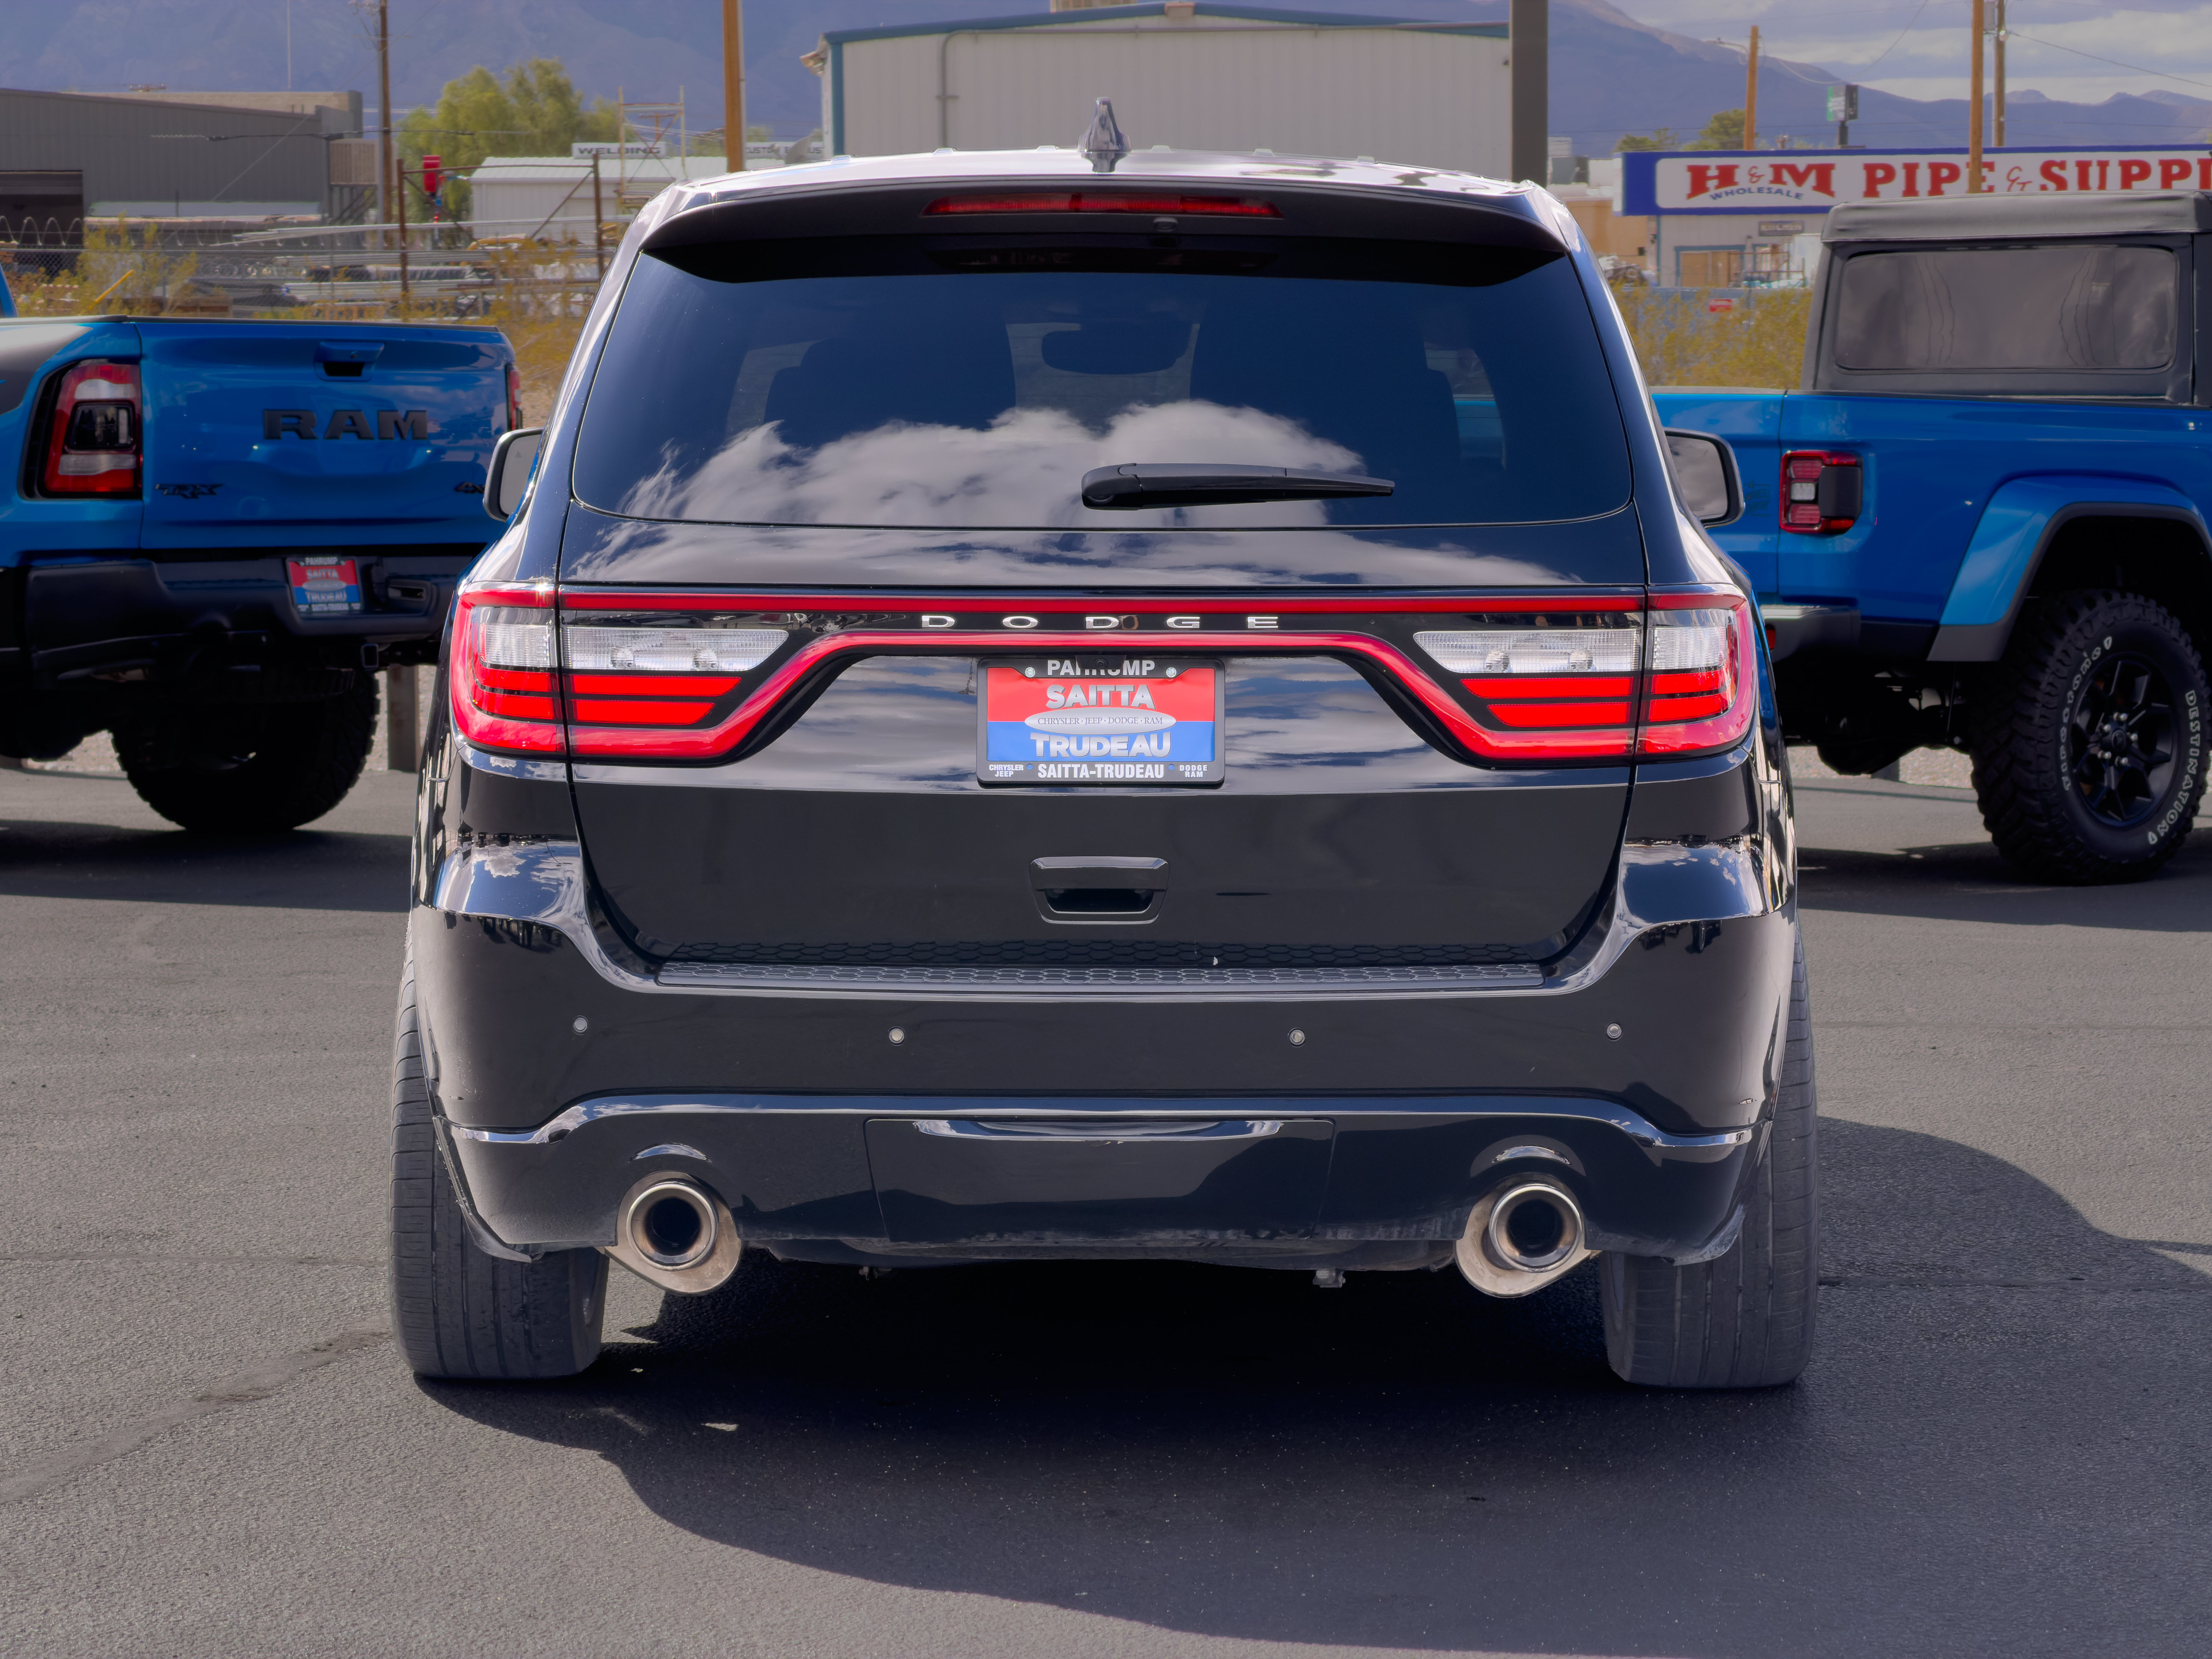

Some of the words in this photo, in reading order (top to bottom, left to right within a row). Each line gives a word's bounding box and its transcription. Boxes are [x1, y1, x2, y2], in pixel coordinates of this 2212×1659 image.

[1863, 161, 1995, 198] PIPE
[1709, 187, 1804, 200] WHOLESALE
[263, 409, 428, 440] RAM
[155, 483, 224, 499] TRX
[305, 557, 338, 565] PAHRUMP
[306, 568, 339, 580] SAITTA
[305, 590, 347, 603] TRUDEAU
[921, 615, 1279, 629] DODGE
[1046, 684, 1156, 710] SAITTA
[1084, 717, 1103, 725] JEEP
[1030, 732, 1171, 758] TRUDEAU
[1038, 763, 1164, 778] SAITTA-TRUDEAU
[2156, 690, 2200, 837] DESTINATION
